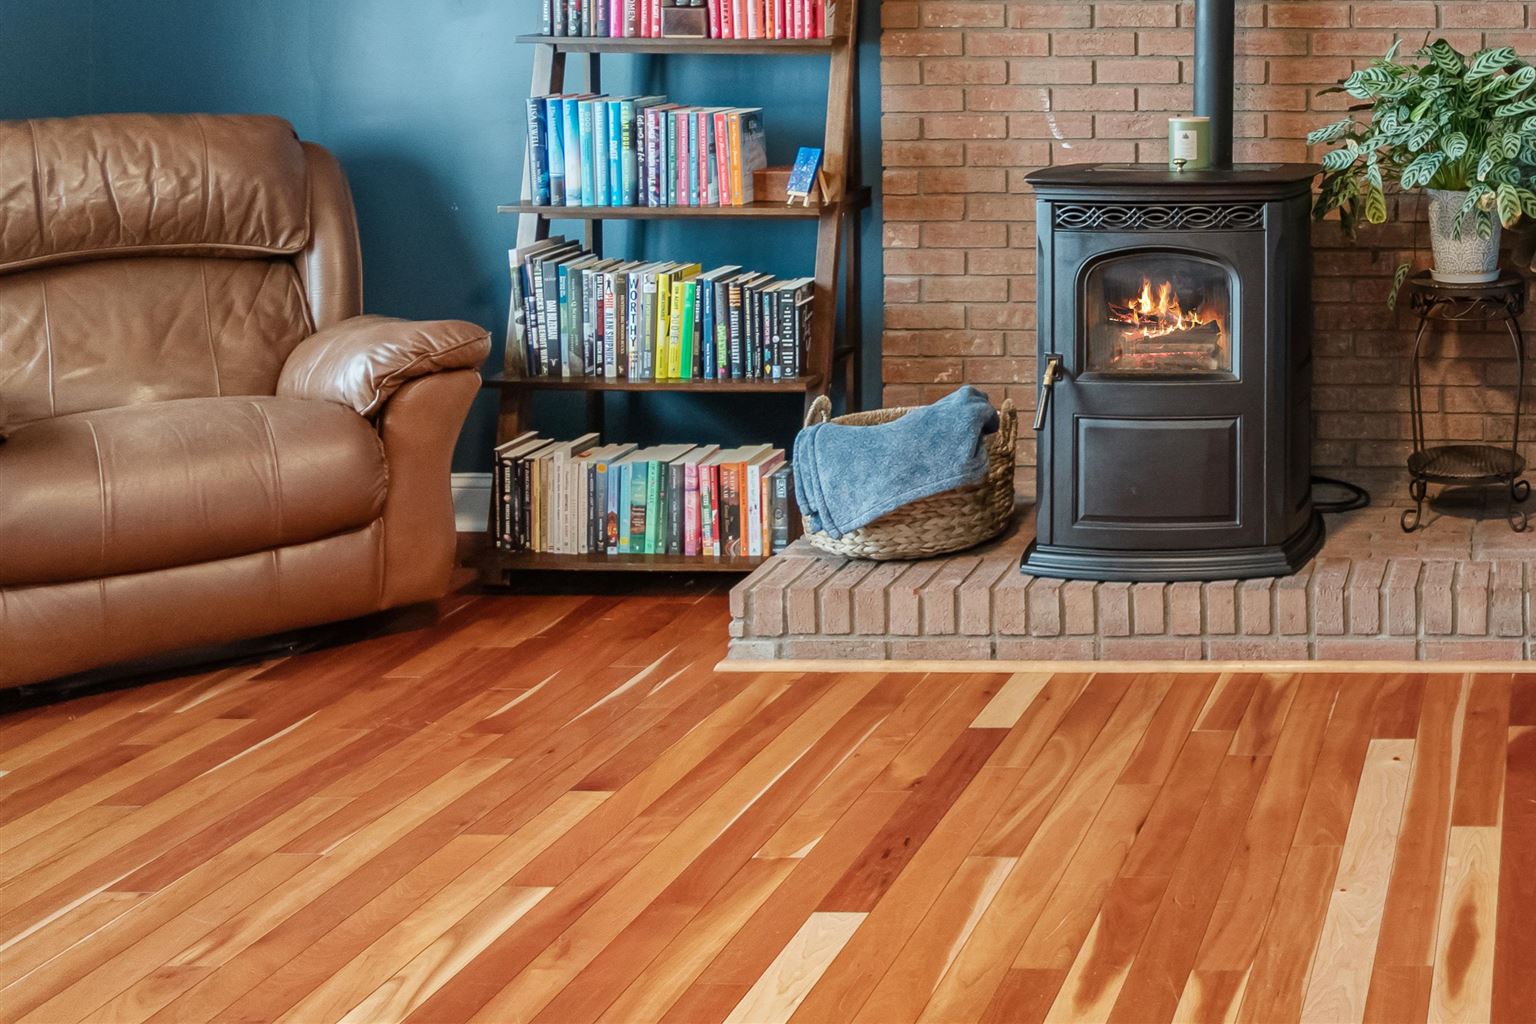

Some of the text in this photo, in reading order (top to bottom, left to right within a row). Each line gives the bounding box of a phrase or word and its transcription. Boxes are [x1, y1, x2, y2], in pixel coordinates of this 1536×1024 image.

[529, 104, 537, 120] LISA
[534, 276, 543, 288] BIG
[535, 289, 544, 311] BUCKS
[546, 300, 557, 312] DAN
[731, 287, 740, 307] JAMES
[537, 312, 545, 323] THE
[630, 279, 639, 347] WORTHY
[605, 293, 614, 366] PHIL ALAN SHIPNUCK
[540, 349, 548, 364] WAY
[732, 339, 740, 364] EVERETT
